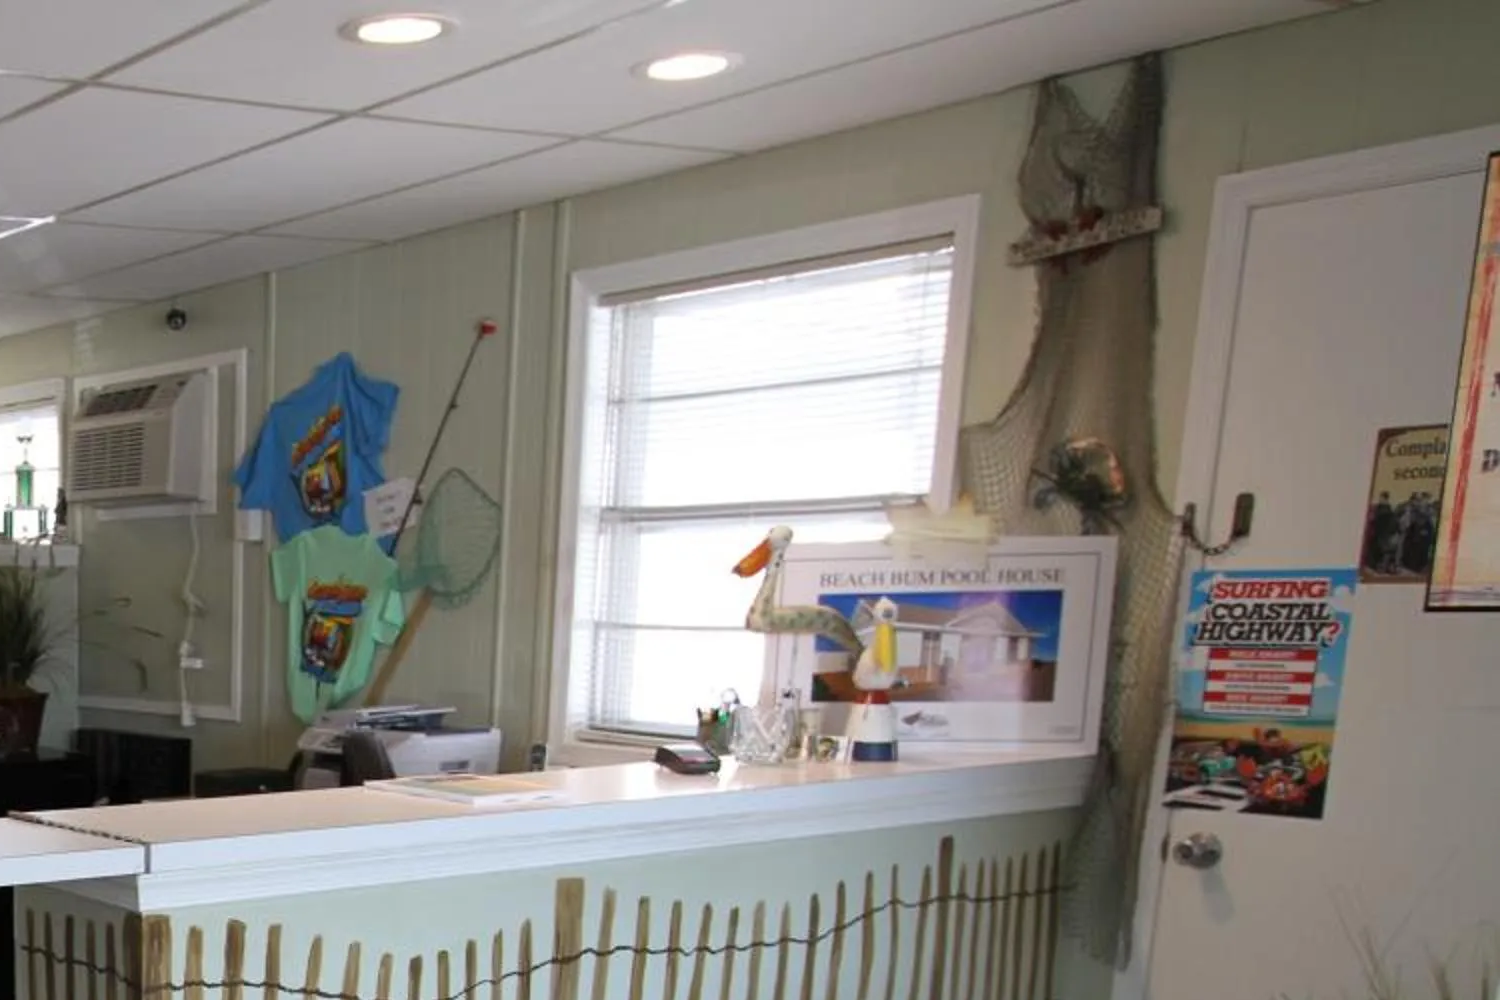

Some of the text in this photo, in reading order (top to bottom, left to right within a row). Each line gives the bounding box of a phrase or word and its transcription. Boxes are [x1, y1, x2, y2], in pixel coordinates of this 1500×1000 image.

[1385, 437, 1447, 460] Compla
[1392, 466, 1446, 481] secon
[819, 568, 1066, 589] BEACH BUM POOL HOUSE
[1213, 581, 1328, 599] SURFING
[1211, 603, 1331, 621] COASTAL
[1197, 621, 1341, 643] HIGHWAY?
